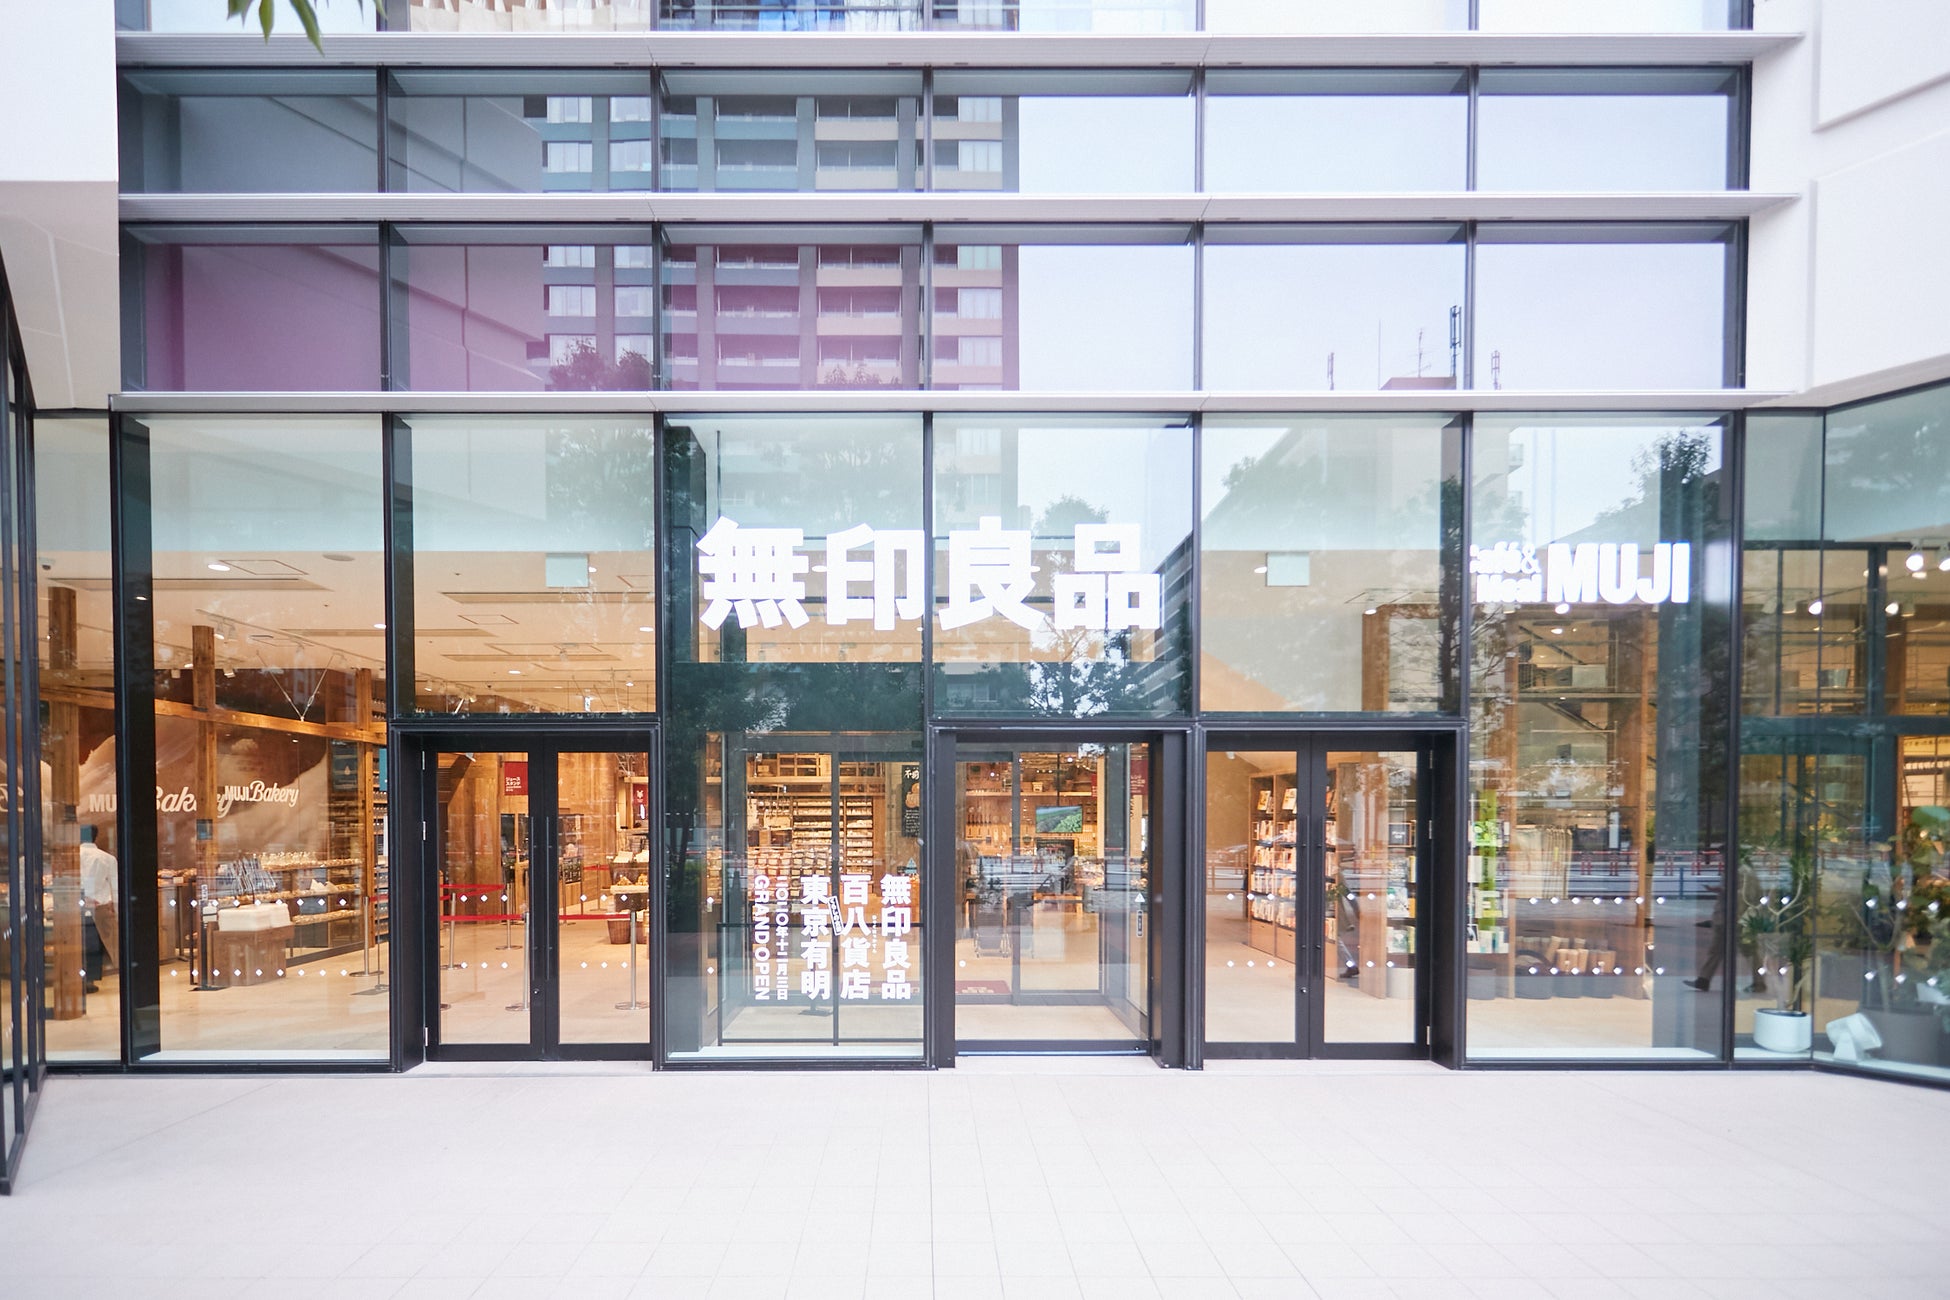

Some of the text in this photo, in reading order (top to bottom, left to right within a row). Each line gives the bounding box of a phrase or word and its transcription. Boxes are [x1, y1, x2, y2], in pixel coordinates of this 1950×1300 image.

[696, 516, 1161, 630] 無印良品
[1548, 543, 1690, 604] MUJI
[90, 794, 117, 812] MU
[225, 780, 299, 807] MUJI Bakery
[755, 875, 770, 1000] GRAND OPEN
[800, 874, 831, 1000] 東京有明
[840, 874, 871, 1000] 百八貨店
[880, 874, 912, 1000] 無印良品
